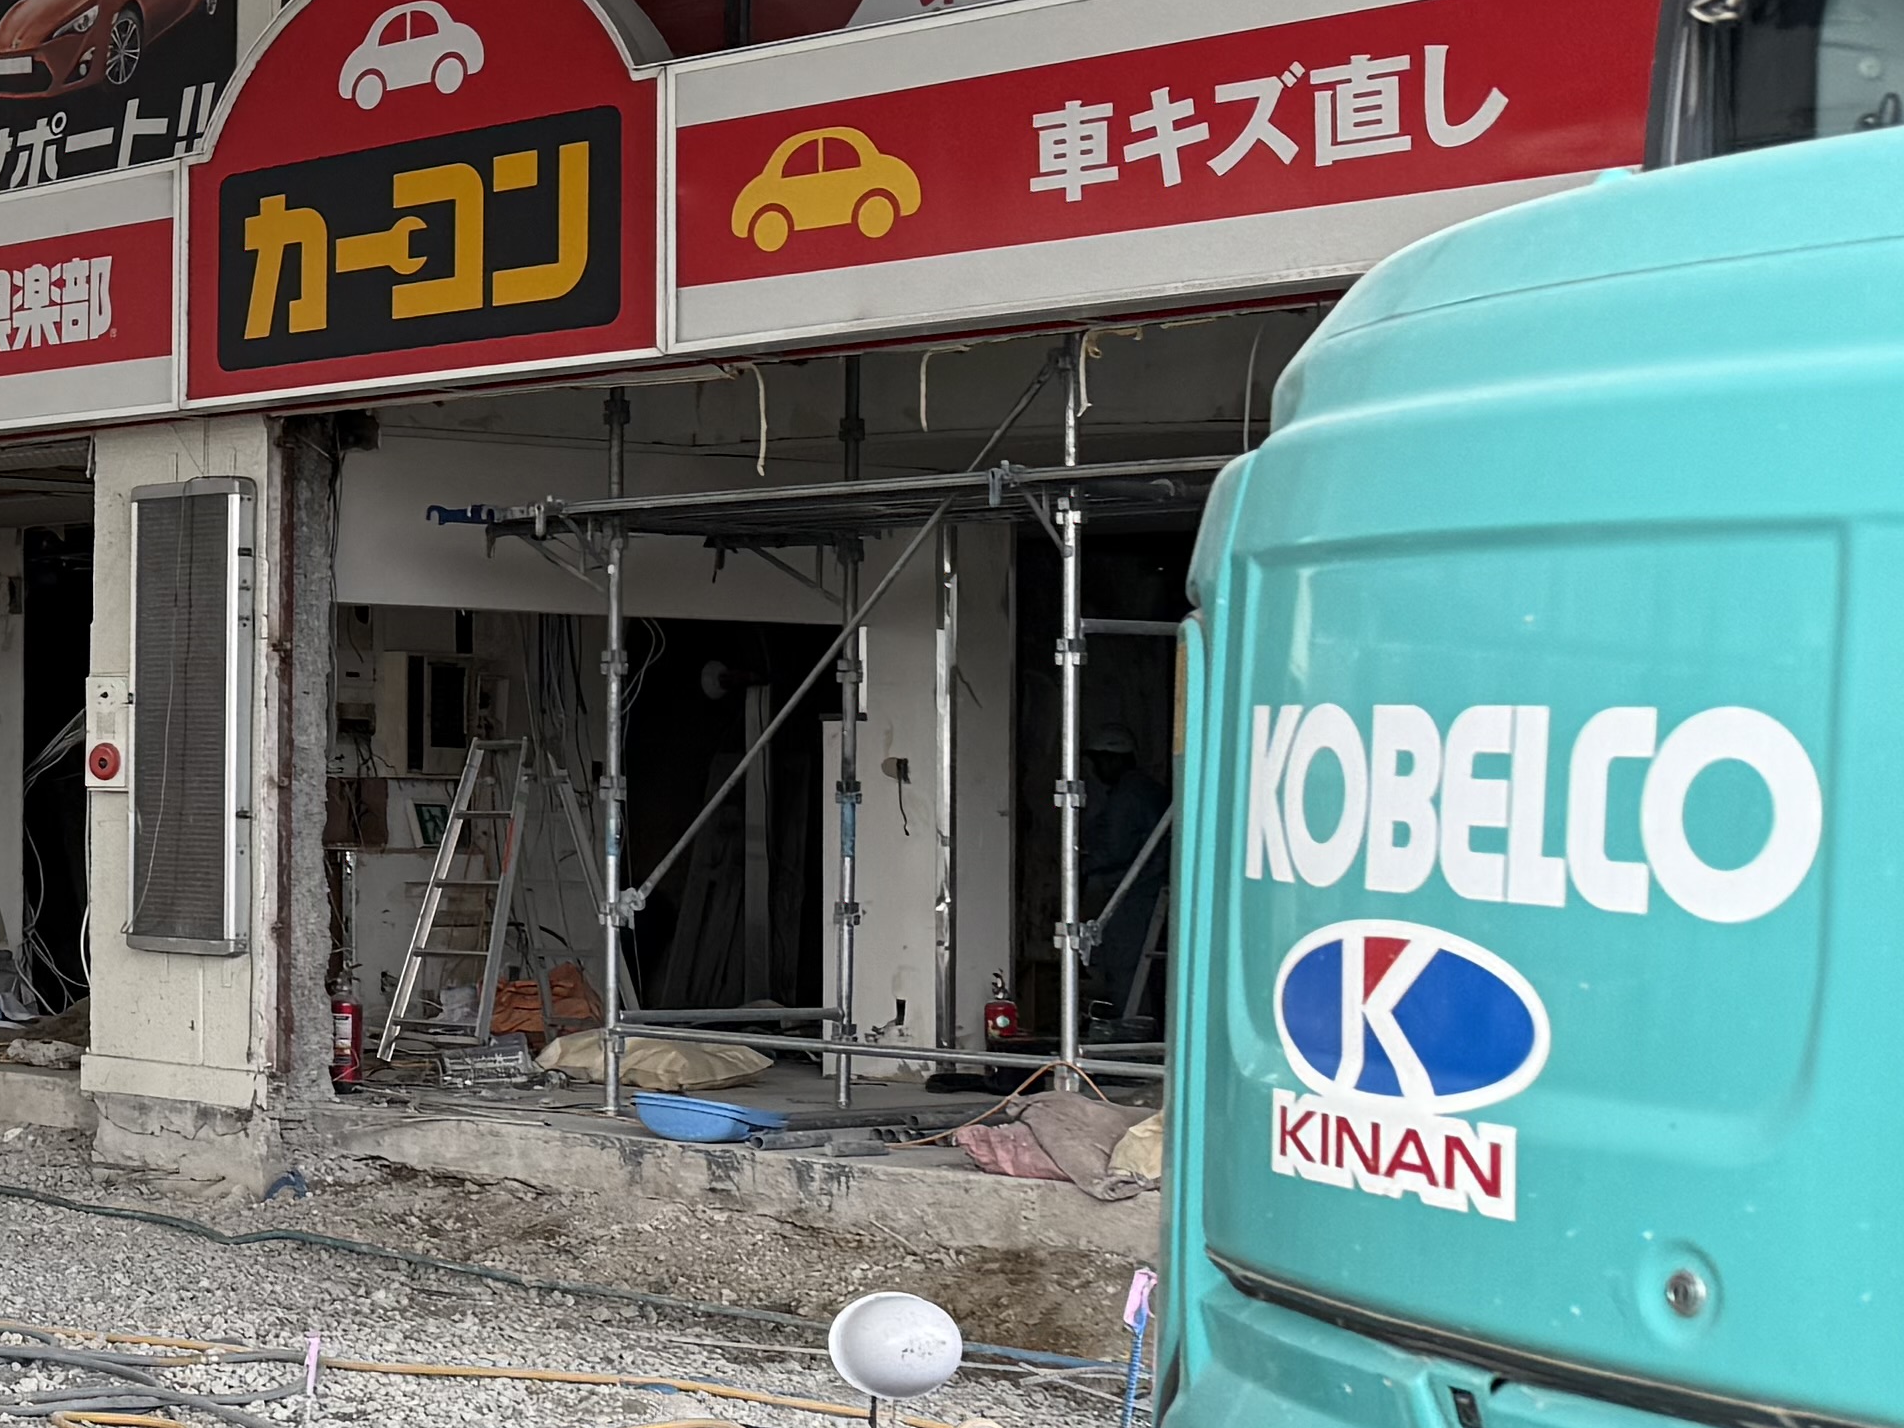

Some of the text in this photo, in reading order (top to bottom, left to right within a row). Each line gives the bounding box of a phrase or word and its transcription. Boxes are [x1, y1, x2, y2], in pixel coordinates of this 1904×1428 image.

[1029, 44, 1509, 202] 車キズ直し
[243, 140, 590, 340] カーコン
[1245, 703, 1822, 924] KOBELCO
[1278, 1104, 1503, 1200] KINAN
